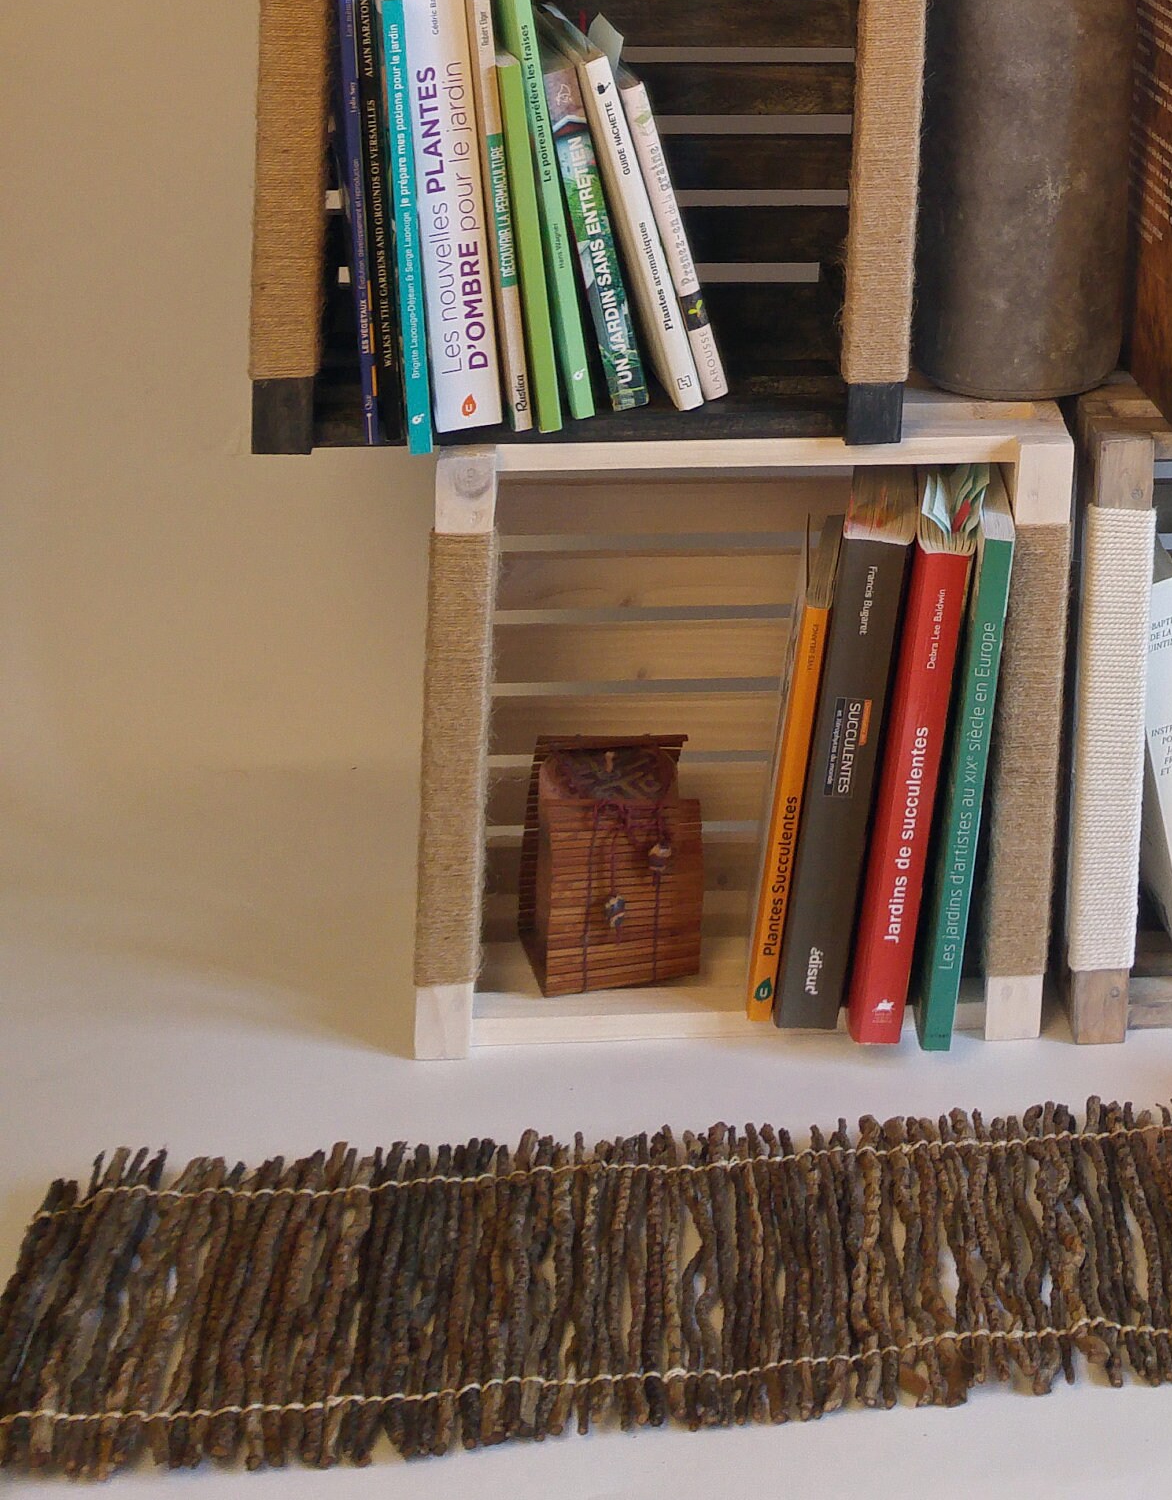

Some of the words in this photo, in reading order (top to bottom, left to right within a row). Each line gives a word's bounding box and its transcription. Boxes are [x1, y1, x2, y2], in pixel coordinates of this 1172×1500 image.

[387, 23, 402, 54] jardin
[430, 10, 440, 36] Cédric
[519, 23, 533, 63] fraises
[361, 50, 373, 78] ALAIN
[390, 54, 400, 66] le
[390, 65, 404, 91] pour
[526, 63, 537, 82] les
[392, 90, 408, 131] potions
[441, 60, 473, 138] jardin
[528, 81, 545, 125] préfère
[366, 99, 379, 162] VERSAILLES
[415, 65, 447, 195] PLANTES
[604, 100, 624, 148] HACHETTE
[396, 134, 407, 156] mes
[448, 141, 471, 164] le
[536, 124, 552, 170] poireau
[615, 147, 632, 177] GUIDE
[370, 162, 380, 177] OF
[396, 157, 411, 199] prépare
[490, 145, 509, 213] PERMACULTURE
[541, 170, 551, 184] Le
[566, 134, 602, 236] ENTRETIEN
[372, 180, 384, 226] GROUNDS
[455, 172, 481, 233] pour
[375, 226, 385, 252] AND
[498, 230, 516, 279] DÉCOUVRIR
[637, 221, 665, 288] aromatiques
[376, 252, 388, 299] GARDENS
[404, 253, 414, 278] Serge
[428, 201, 457, 322] nouvelles
[589, 239, 612, 288] SANS
[380, 299, 390, 326] THE
[601, 289, 627, 357] JARDIN
[656, 287, 674, 332] Plantes
[382, 327, 390, 342] IN
[441, 330, 463, 377] Les
[383, 343, 393, 368] WALKS
[411, 349, 420, 379] Brigitte
[613, 357, 633, 385] UN
[699, 326, 722, 392] LAROUSSE
[513, 373, 527, 413] Rustica
[864, 565, 878, 598] Francis
[859, 600, 873, 636] Bugaret
[933, 588, 947, 623] Baldwin
[931, 624, 941, 642] Lee
[974, 621, 997, 678] Europe
[1150, 632, 1161, 643] DE
[1161, 628, 1172, 639] LA
[927, 642, 939, 670] Debra
[976, 682, 988, 702] en
[837, 702, 861, 794] SUCCULENTES
[966, 706, 987, 751] siècle
[900, 725, 929, 841] succulentes
[1160, 765, 1172, 776] ET
[961, 787, 976, 808] au
[772, 796, 798, 893] Succulentes
[894, 846, 912, 871] de
[949, 811, 974, 884] d'artistes
[763, 897, 784, 957] Plantes
[884, 875, 908, 945] Jardins
[944, 888, 963, 942] jardins
[939, 944, 956, 970] Les
